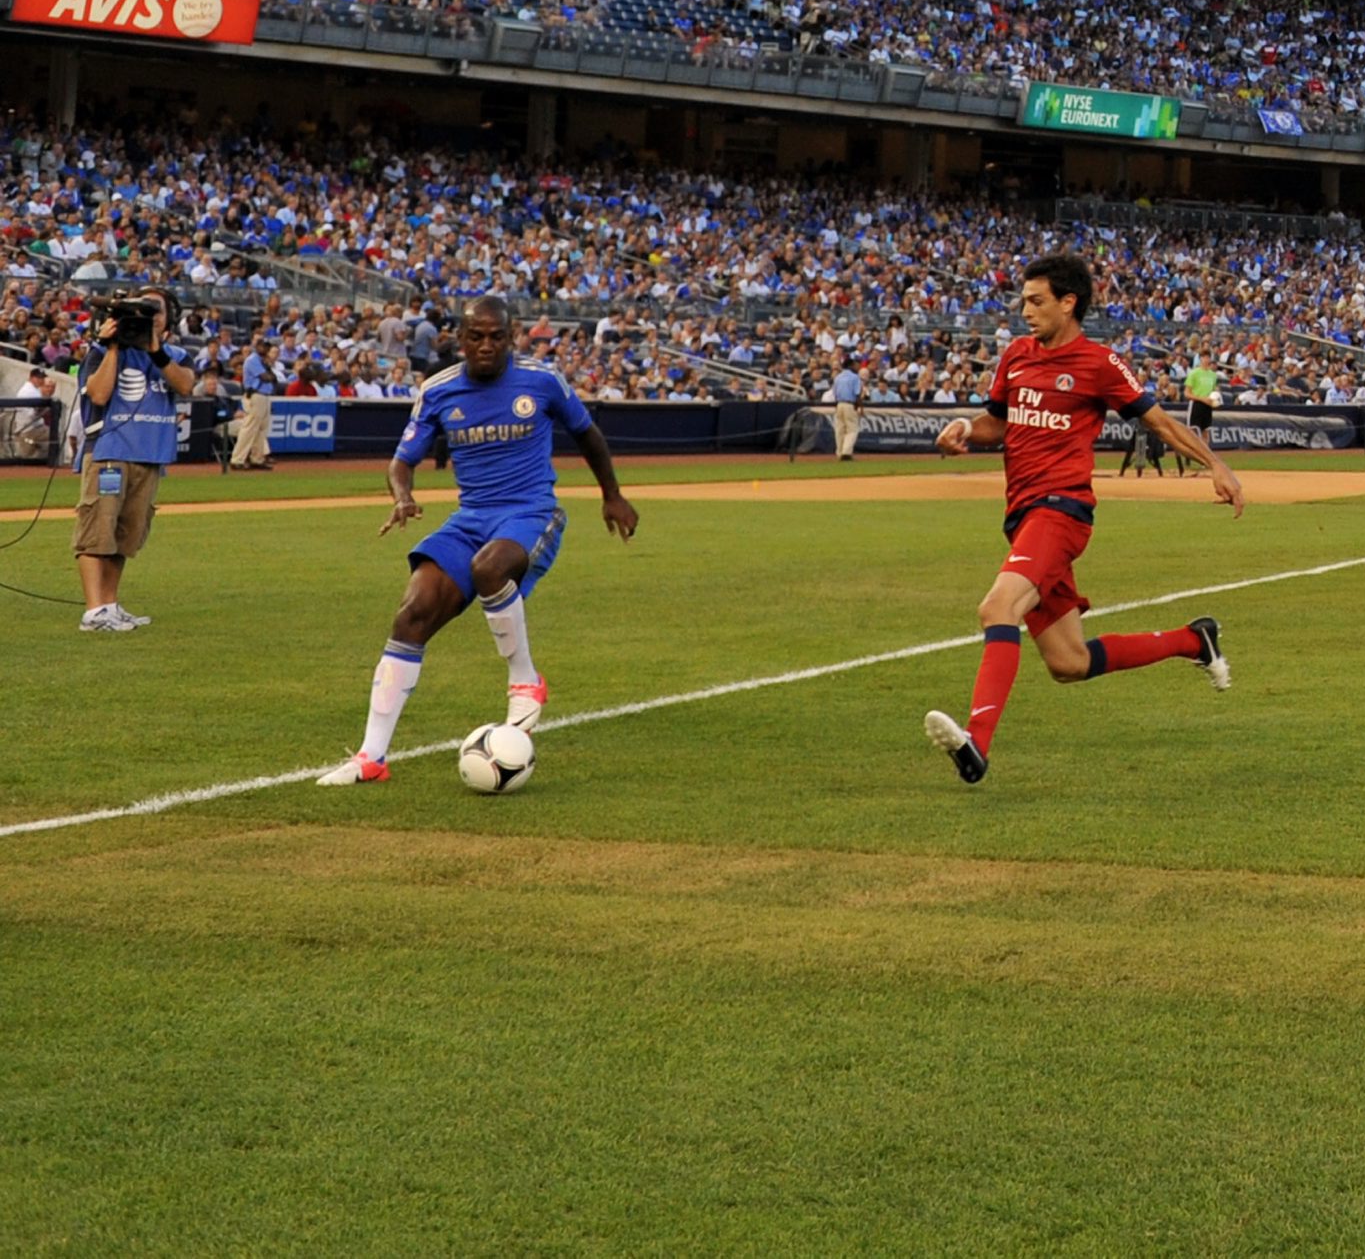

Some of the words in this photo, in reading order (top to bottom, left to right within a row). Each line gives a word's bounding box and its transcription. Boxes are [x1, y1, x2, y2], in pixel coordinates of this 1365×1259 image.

[1063, 93, 1093, 111] NYSE
[1060, 109, 1120, 129] EURONEXT
[1018, 387, 1043, 407] Fly
[267, 414, 334, 438] EICO
[1007, 404, 1071, 430] mirates
[1209, 426, 1309, 447] EATHERPROOF
